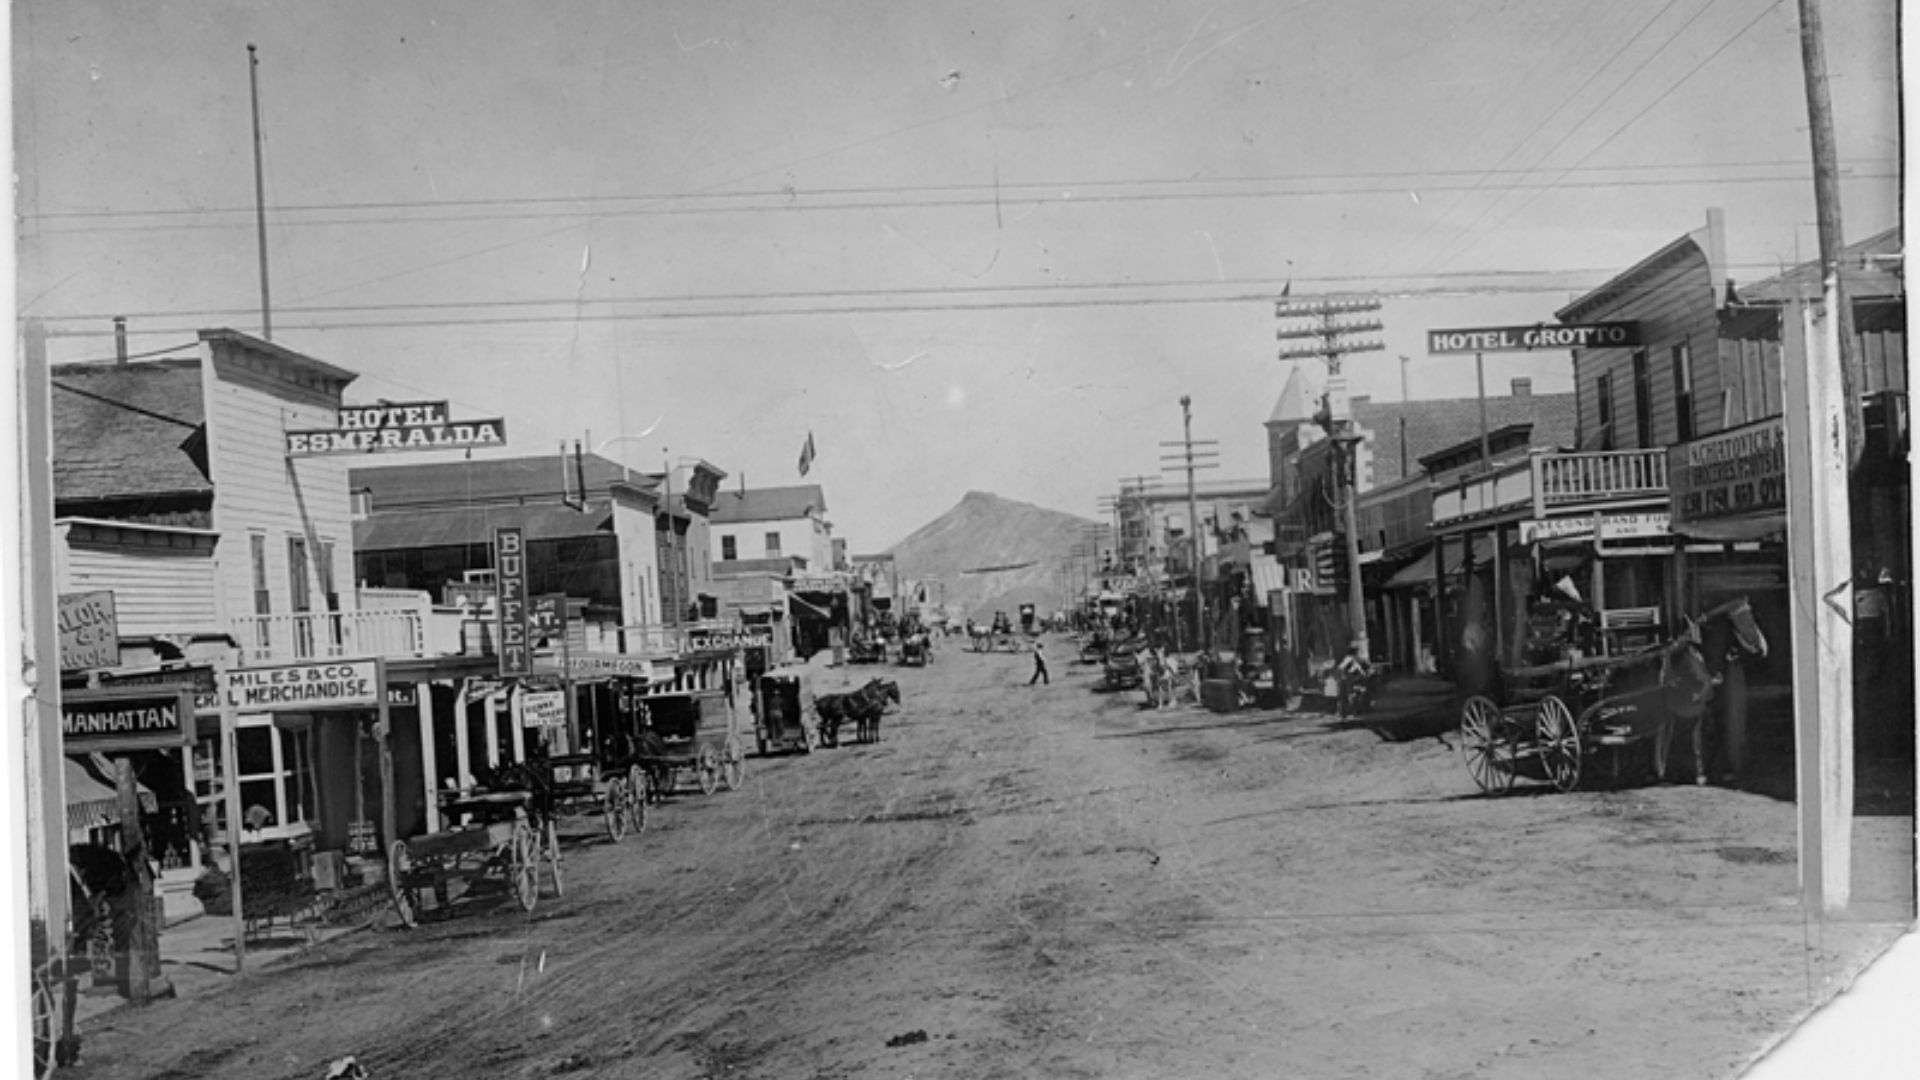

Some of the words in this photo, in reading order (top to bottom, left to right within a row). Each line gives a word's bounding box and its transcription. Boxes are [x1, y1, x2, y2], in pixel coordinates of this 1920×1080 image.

[1433, 331, 1516, 350] HOTEL
[1523, 326, 1626, 345] GROTTO
[340, 405, 444, 429] HOTEL
[287, 424, 500, 453] ESMERALDA
[500, 533, 524, 670] BUFFET
[229, 669, 301, 687] MILES
[63, 704, 177, 733] MANHATTAN
